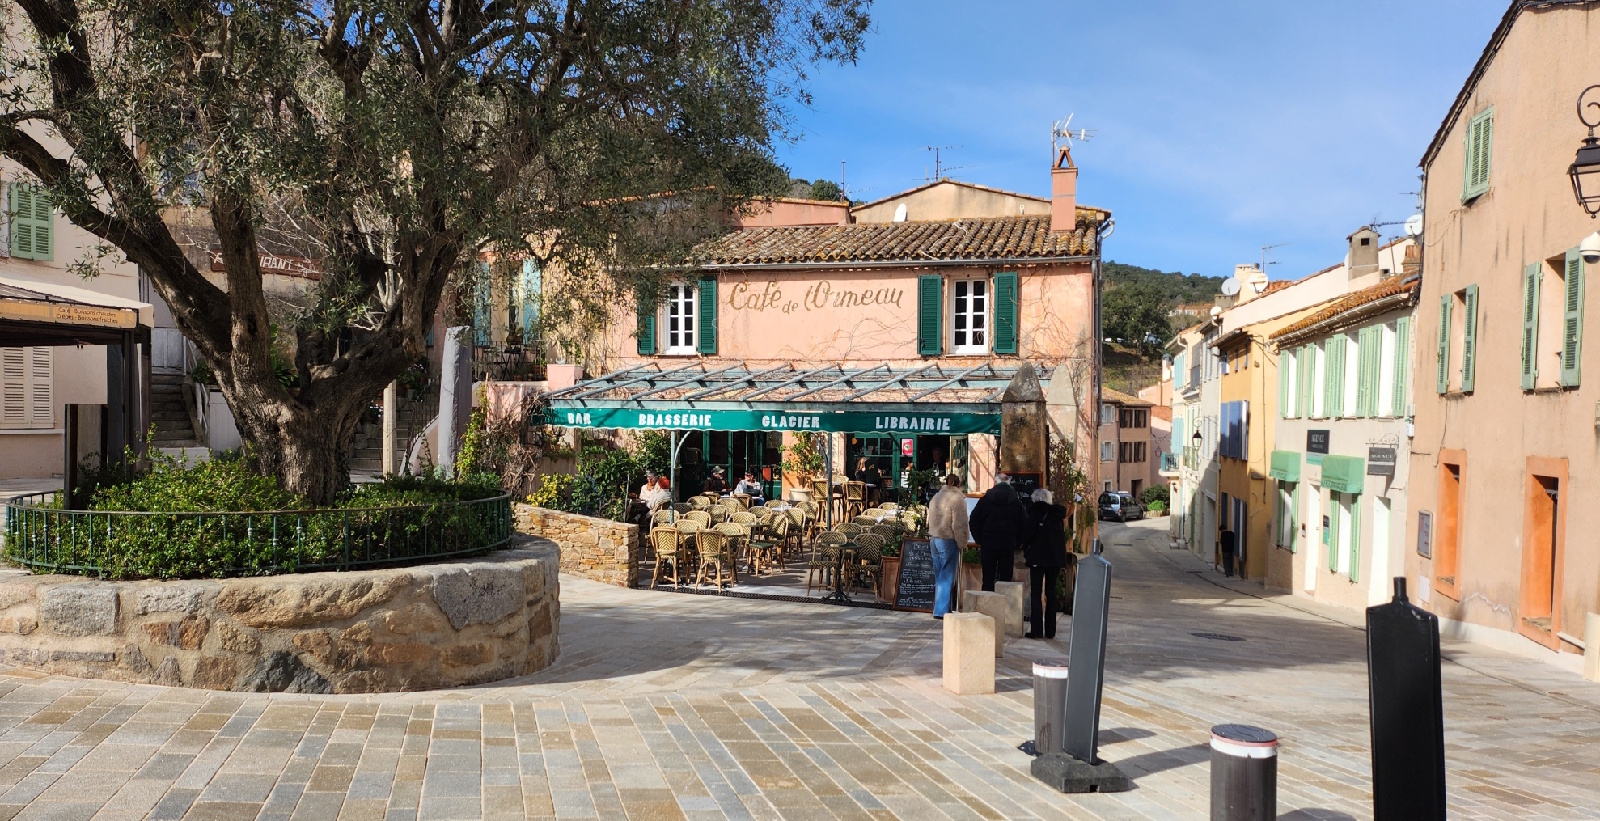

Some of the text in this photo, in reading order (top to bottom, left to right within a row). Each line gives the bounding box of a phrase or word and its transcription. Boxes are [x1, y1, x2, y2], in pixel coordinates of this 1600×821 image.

[729, 280, 782, 312] Café
[782, 300, 798, 314] de
[567, 412, 591, 425] BAR
[638, 413, 712, 427] BRASSERIE
[762, 415, 820, 428] GLACIER
[875, 416, 950, 431] LIBRAIRIE
